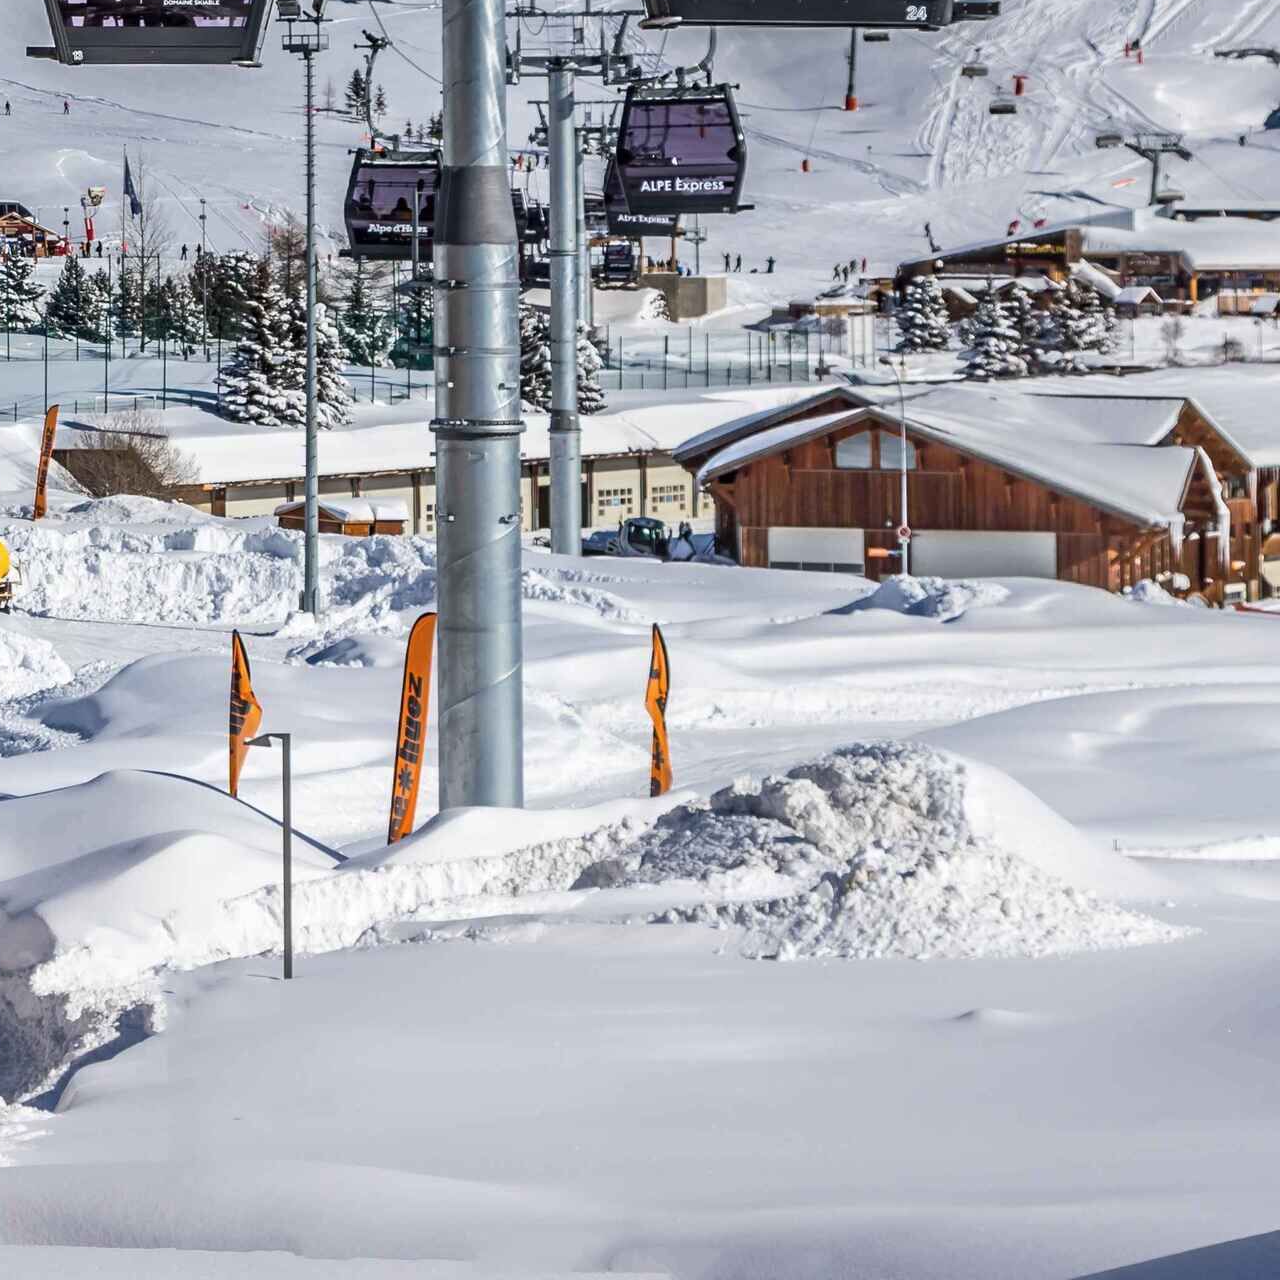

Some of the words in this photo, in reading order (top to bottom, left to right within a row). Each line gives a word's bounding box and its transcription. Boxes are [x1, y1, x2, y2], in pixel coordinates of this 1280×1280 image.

[906, 5, 928, 21] 24
[640, 179, 672, 193] ALPE
[675, 179, 725, 194] Express
[367, 223, 392, 235] Alpe
[400, 672, 423, 764] huez
